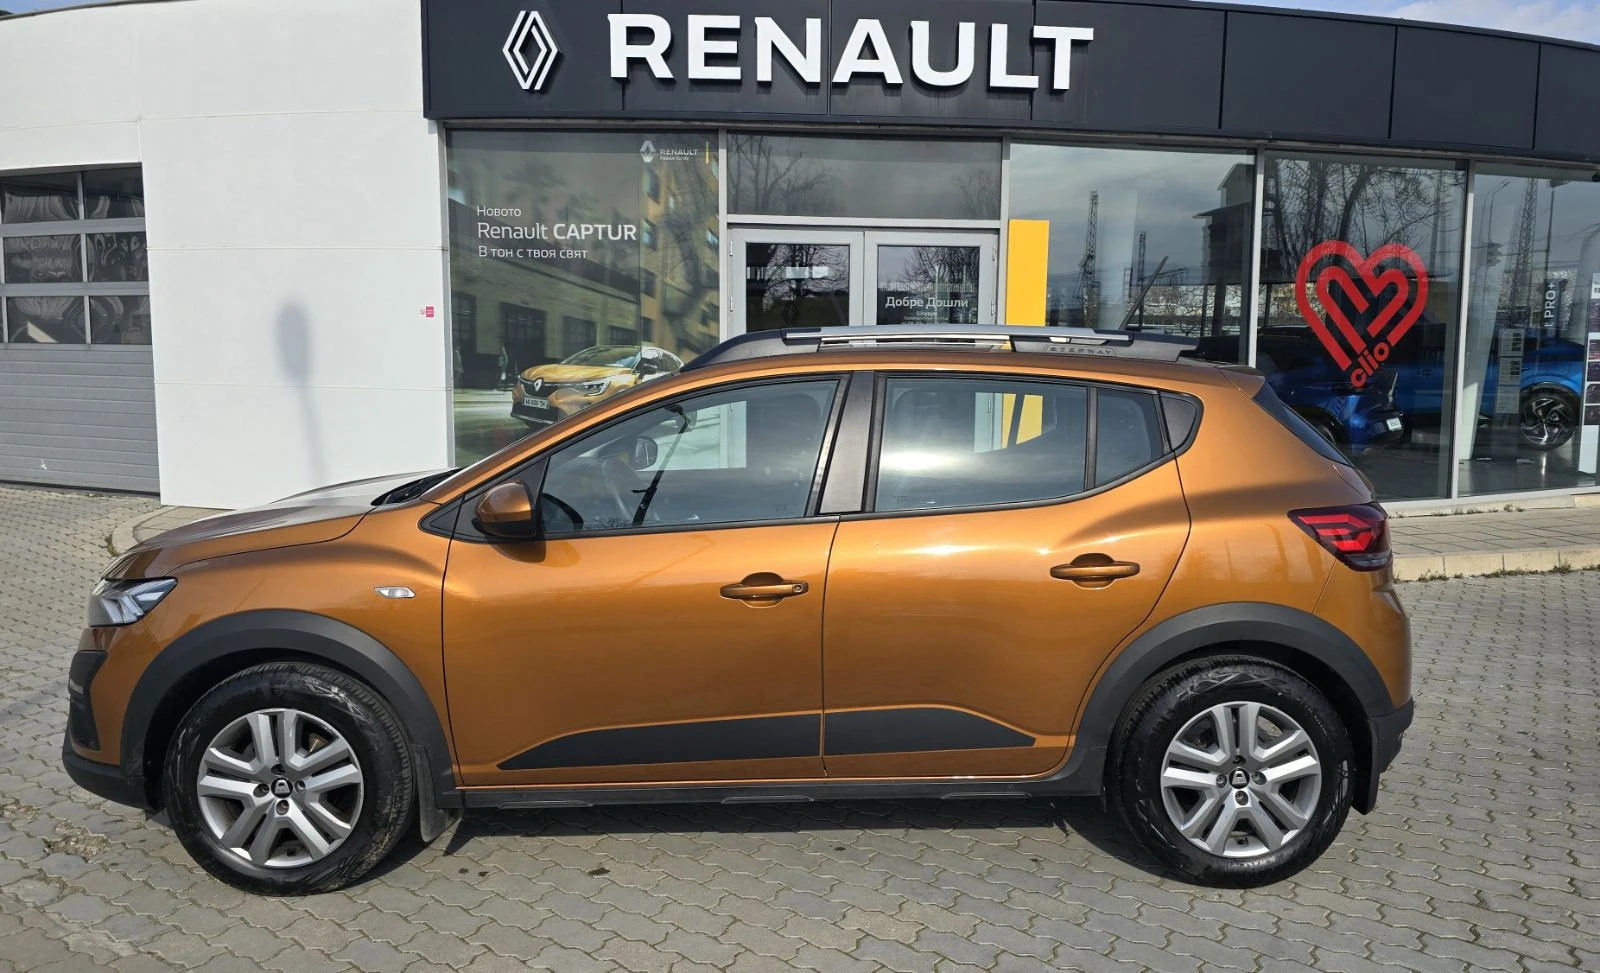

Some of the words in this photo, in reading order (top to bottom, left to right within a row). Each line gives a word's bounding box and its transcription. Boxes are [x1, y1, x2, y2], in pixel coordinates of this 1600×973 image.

[607, 14, 1094, 91] RENAULT
[476, 205, 522, 217] Новото
[477, 222, 549, 240] Renault
[553, 223, 637, 241] CAPTUR
[478, 245, 488, 257] В
[490, 248, 514, 258] тон
[516, 248, 524, 258] с
[526, 249, 556, 258] твоя
[559, 249, 588, 259] свят
[885, 296, 925, 309] Добре
[925, 297, 969, 309] Дошли
[1544, 282, 1557, 318] PRO+
[1049, 345, 1112, 355] STEPWAY
[1350, 341, 1390, 388] clio
